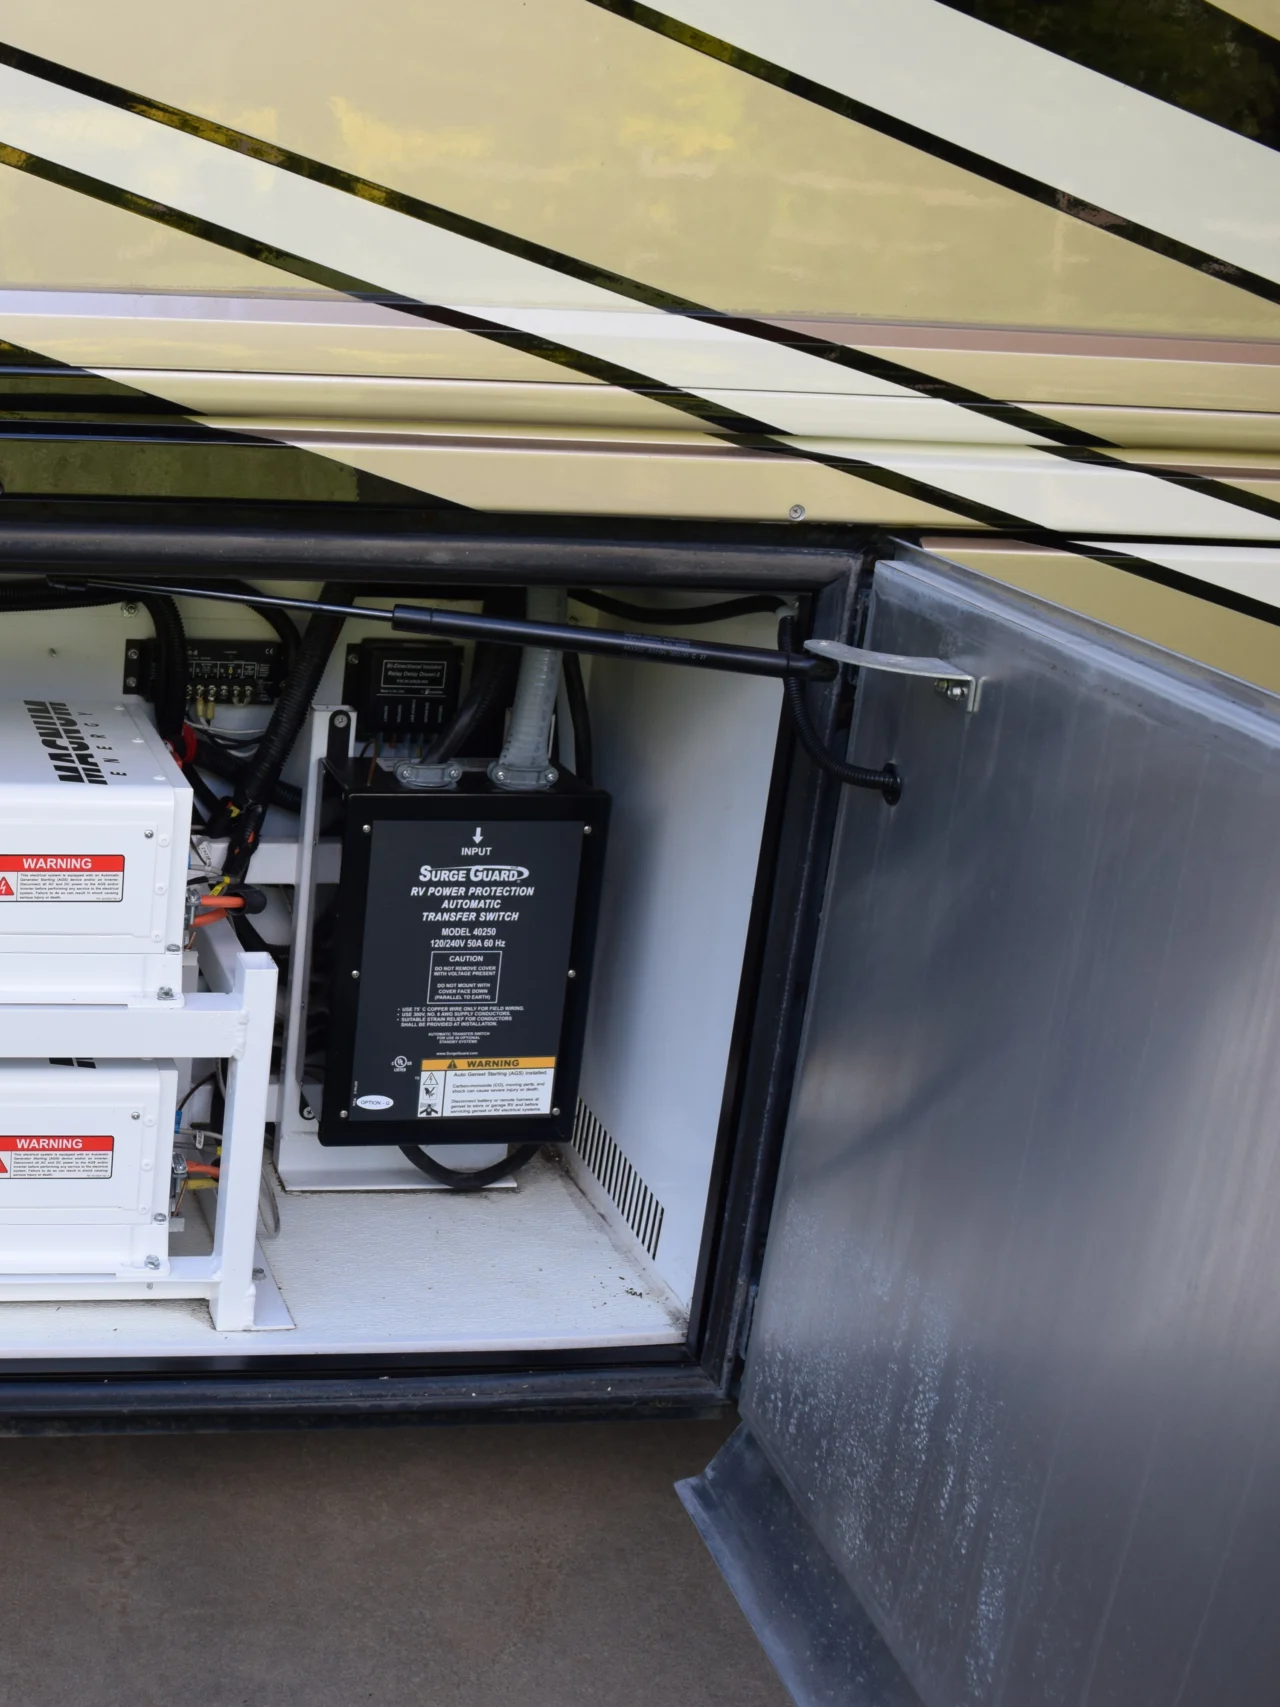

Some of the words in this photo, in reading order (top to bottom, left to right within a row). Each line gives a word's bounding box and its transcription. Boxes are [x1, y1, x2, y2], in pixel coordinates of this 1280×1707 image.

[23, 699, 108, 785] MAGNUM
[461, 847, 492, 856] INPUT
[23, 858, 92, 869] WARNING
[411, 887, 426, 896] RV
[428, 887, 465, 896] POWER
[468, 887, 535, 896] PROTECTION
[441, 899, 501, 909] AUTOMATIC
[422, 912, 476, 921] TRANSFER
[479, 912, 519, 921] SWITCH
[441, 928, 471, 936] MODEL
[473, 928, 497, 936] 40250
[430, 939, 465, 947] 120/240V
[467, 939, 482, 947] 50A
[484, 939, 493, 947] 60
[495, 939, 505, 947] Hz
[467, 1059, 520, 1068] WARNING
[16, 1139, 83, 1149] WARNING
